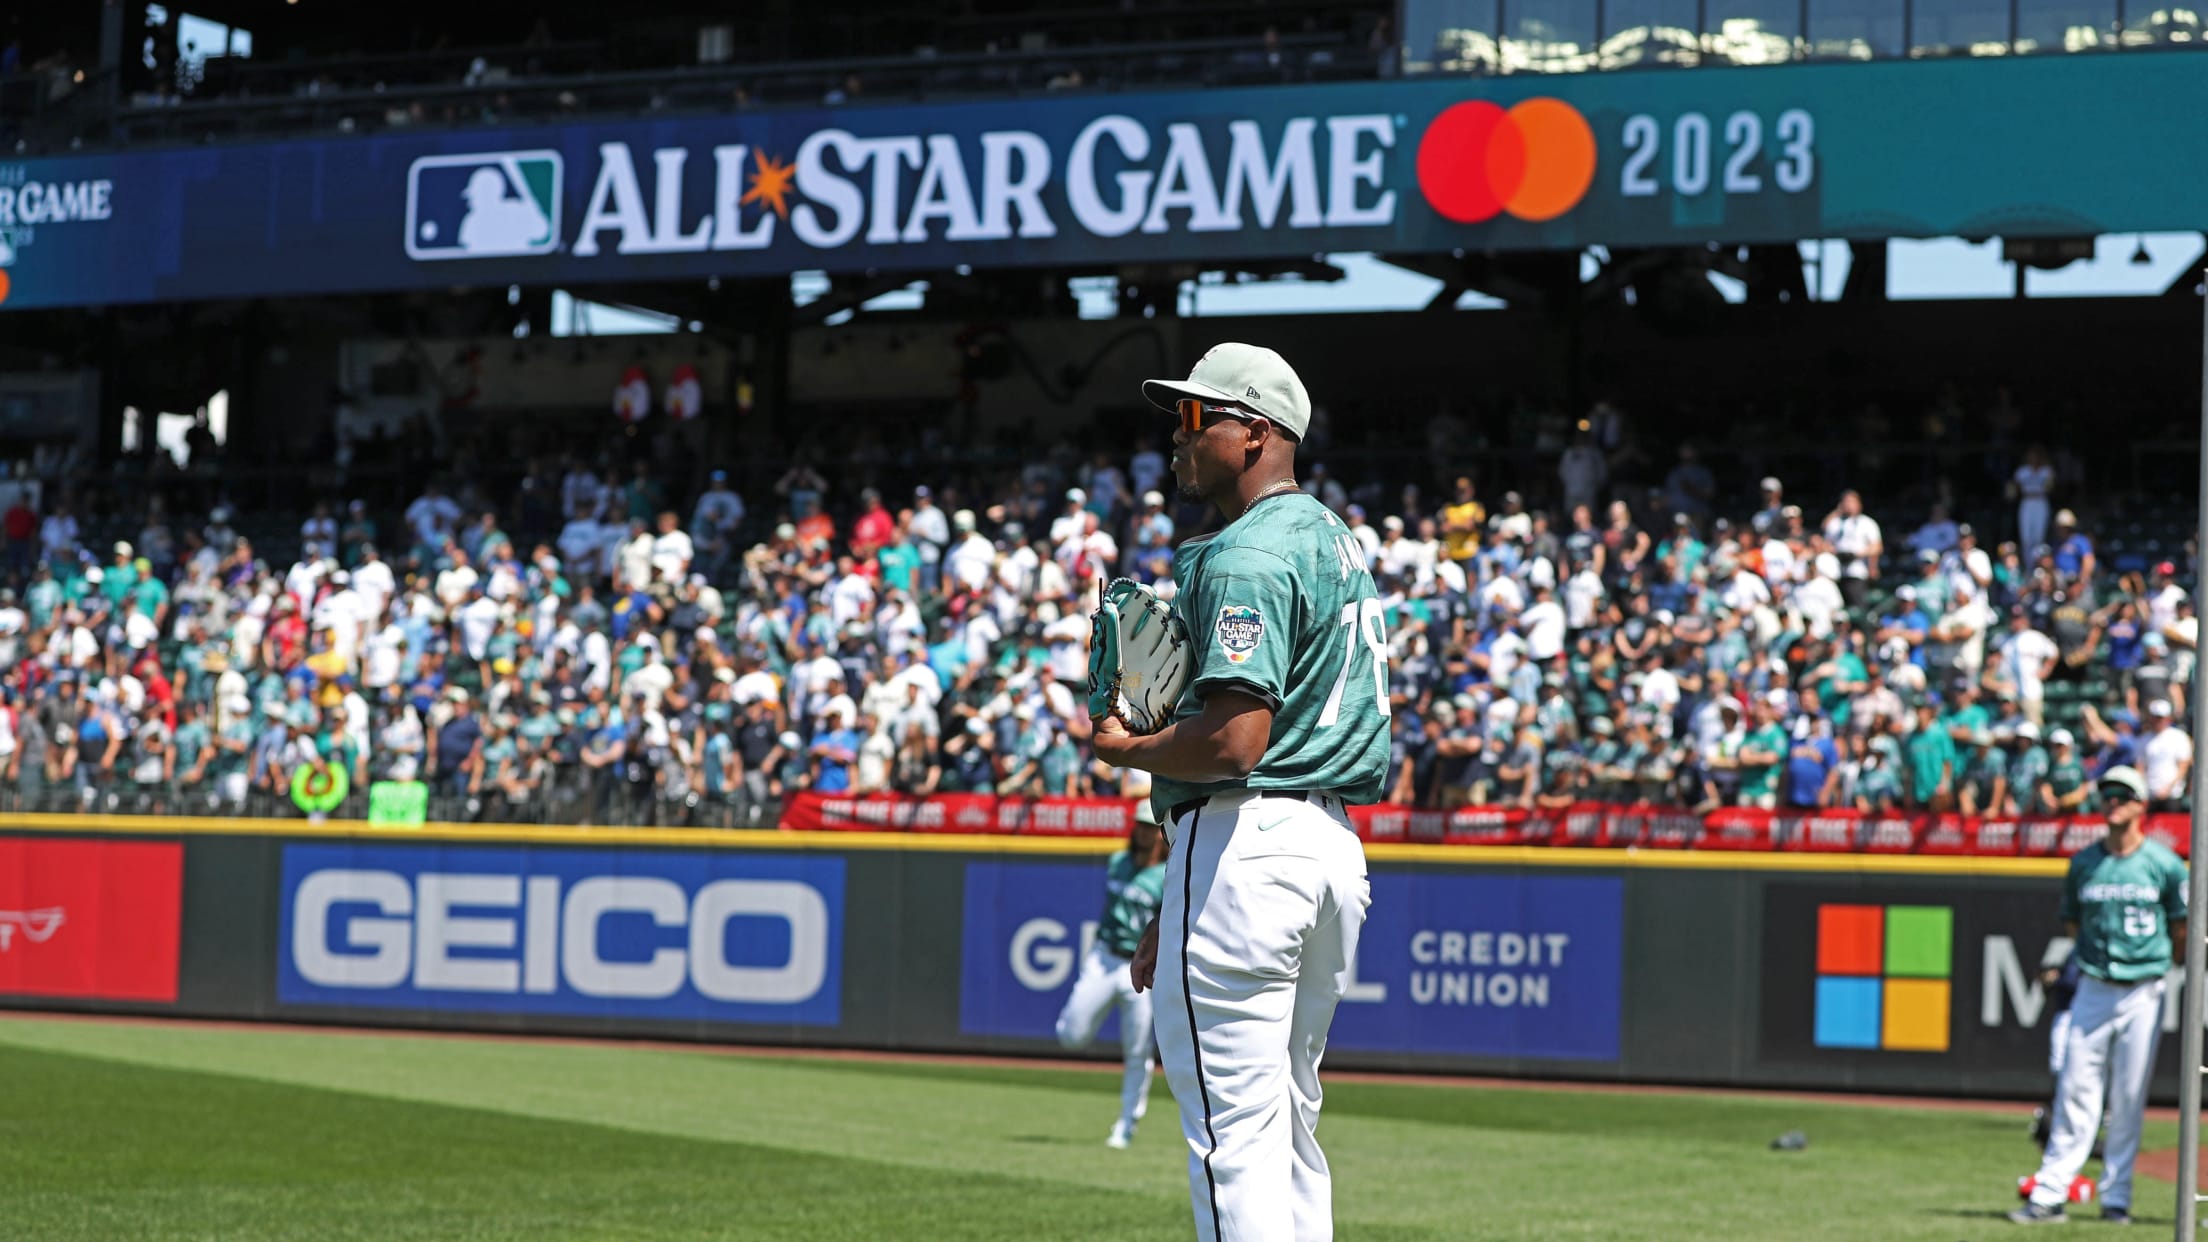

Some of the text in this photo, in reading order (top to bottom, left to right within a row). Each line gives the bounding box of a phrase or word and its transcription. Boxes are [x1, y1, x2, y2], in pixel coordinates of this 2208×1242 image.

[1621, 108, 1814, 195] 2023
[17, 179, 113, 225] GAME
[791, 129, 1057, 248] STAR
[1067, 114, 1396, 237] GAME
[1226, 630, 1253, 640] GAME
[291, 868, 829, 1005] GEICO
[1410, 929, 1570, 967] CREDIT
[1410, 971, 1549, 1007] UNION
